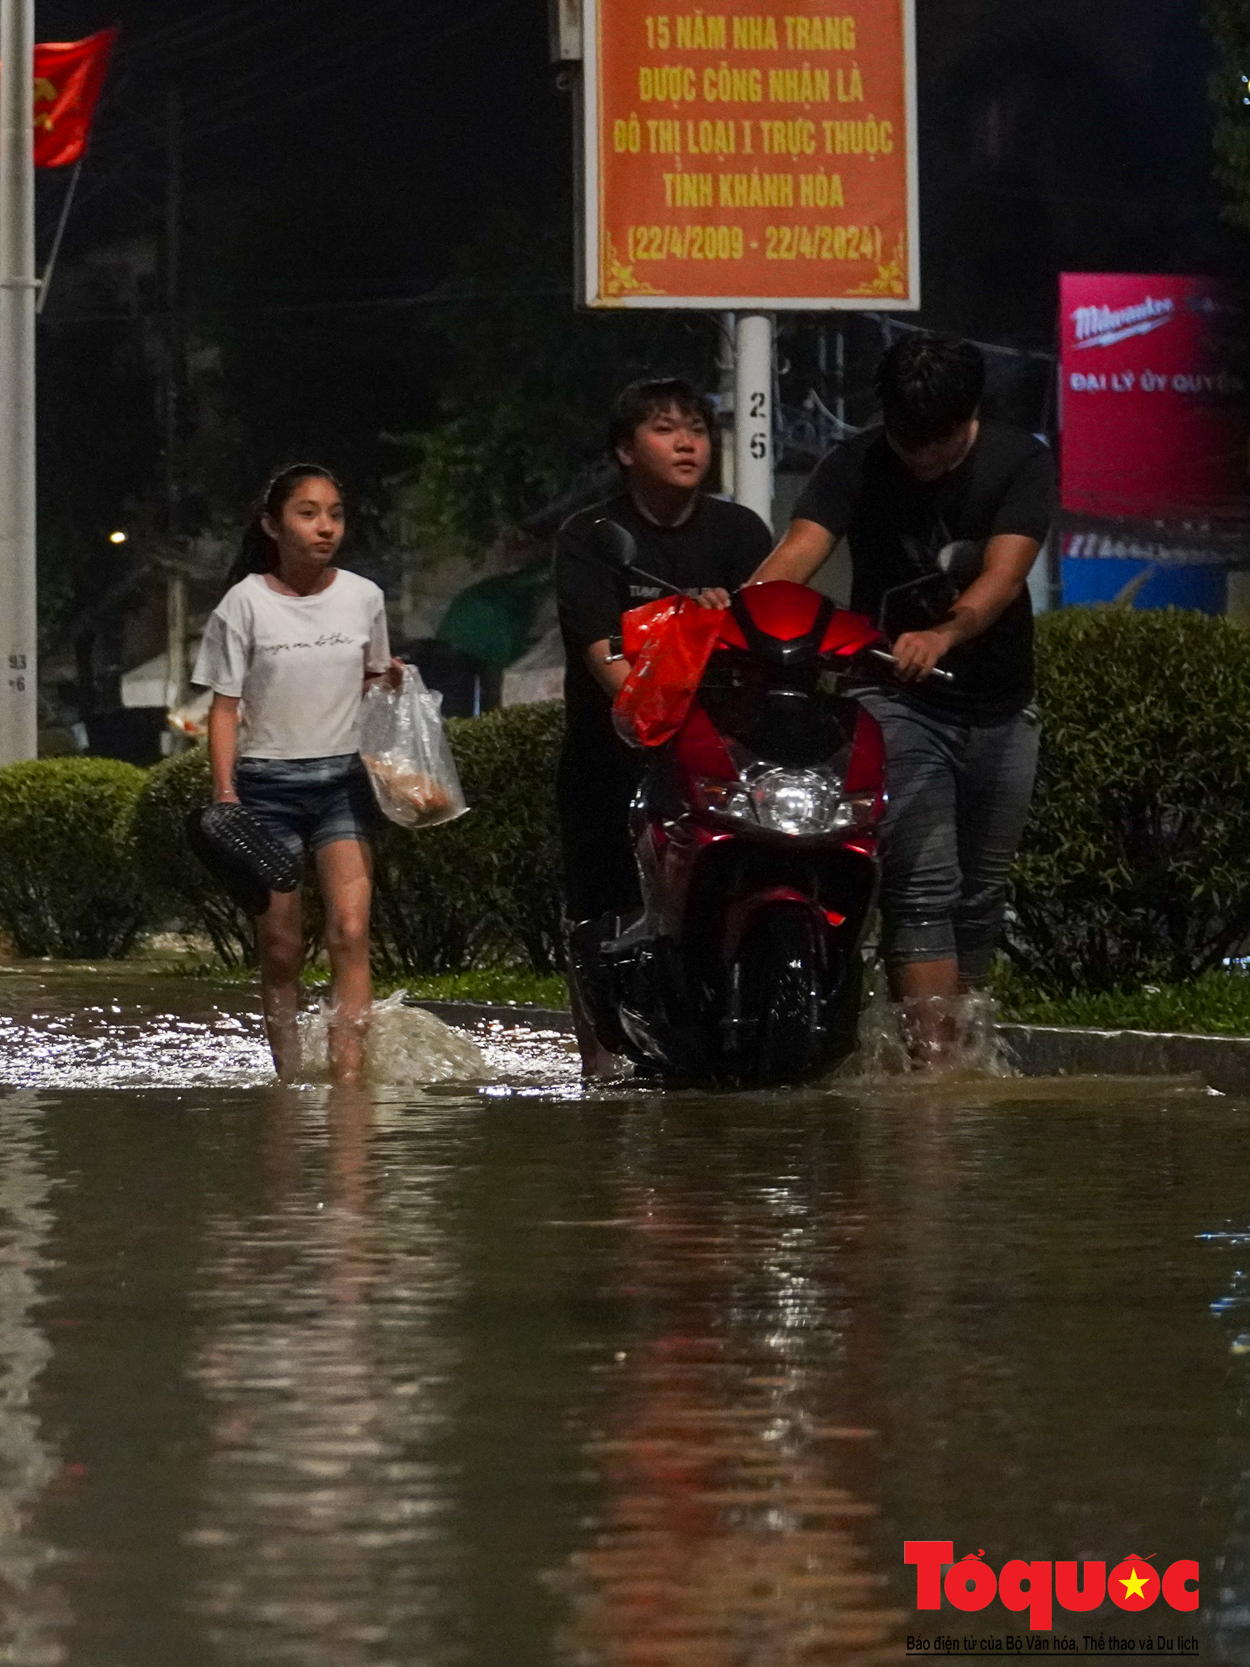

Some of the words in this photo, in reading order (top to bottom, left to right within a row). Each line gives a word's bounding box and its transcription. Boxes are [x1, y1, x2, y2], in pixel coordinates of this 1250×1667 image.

[646, 16, 670, 50] 15
[676, 8, 726, 50] NĂM
[733, 16, 778, 50] NHA
[785, 16, 856, 50] TRANG
[703, 61, 762, 102] CÔNG
[836, 61, 864, 102] LÀ
[613, 111, 641, 153] ĐÔ
[688, 120, 736, 162] LOẠI
[743, 120, 753, 154] I
[822, 112, 894, 162] THUỘC
[719, 166, 794, 208] KHÁNH
[800, 166, 845, 208] HÒA
[627, 225, 744, 263] (22/4/2009
[765, 225, 882, 263] 22/4/2024)
